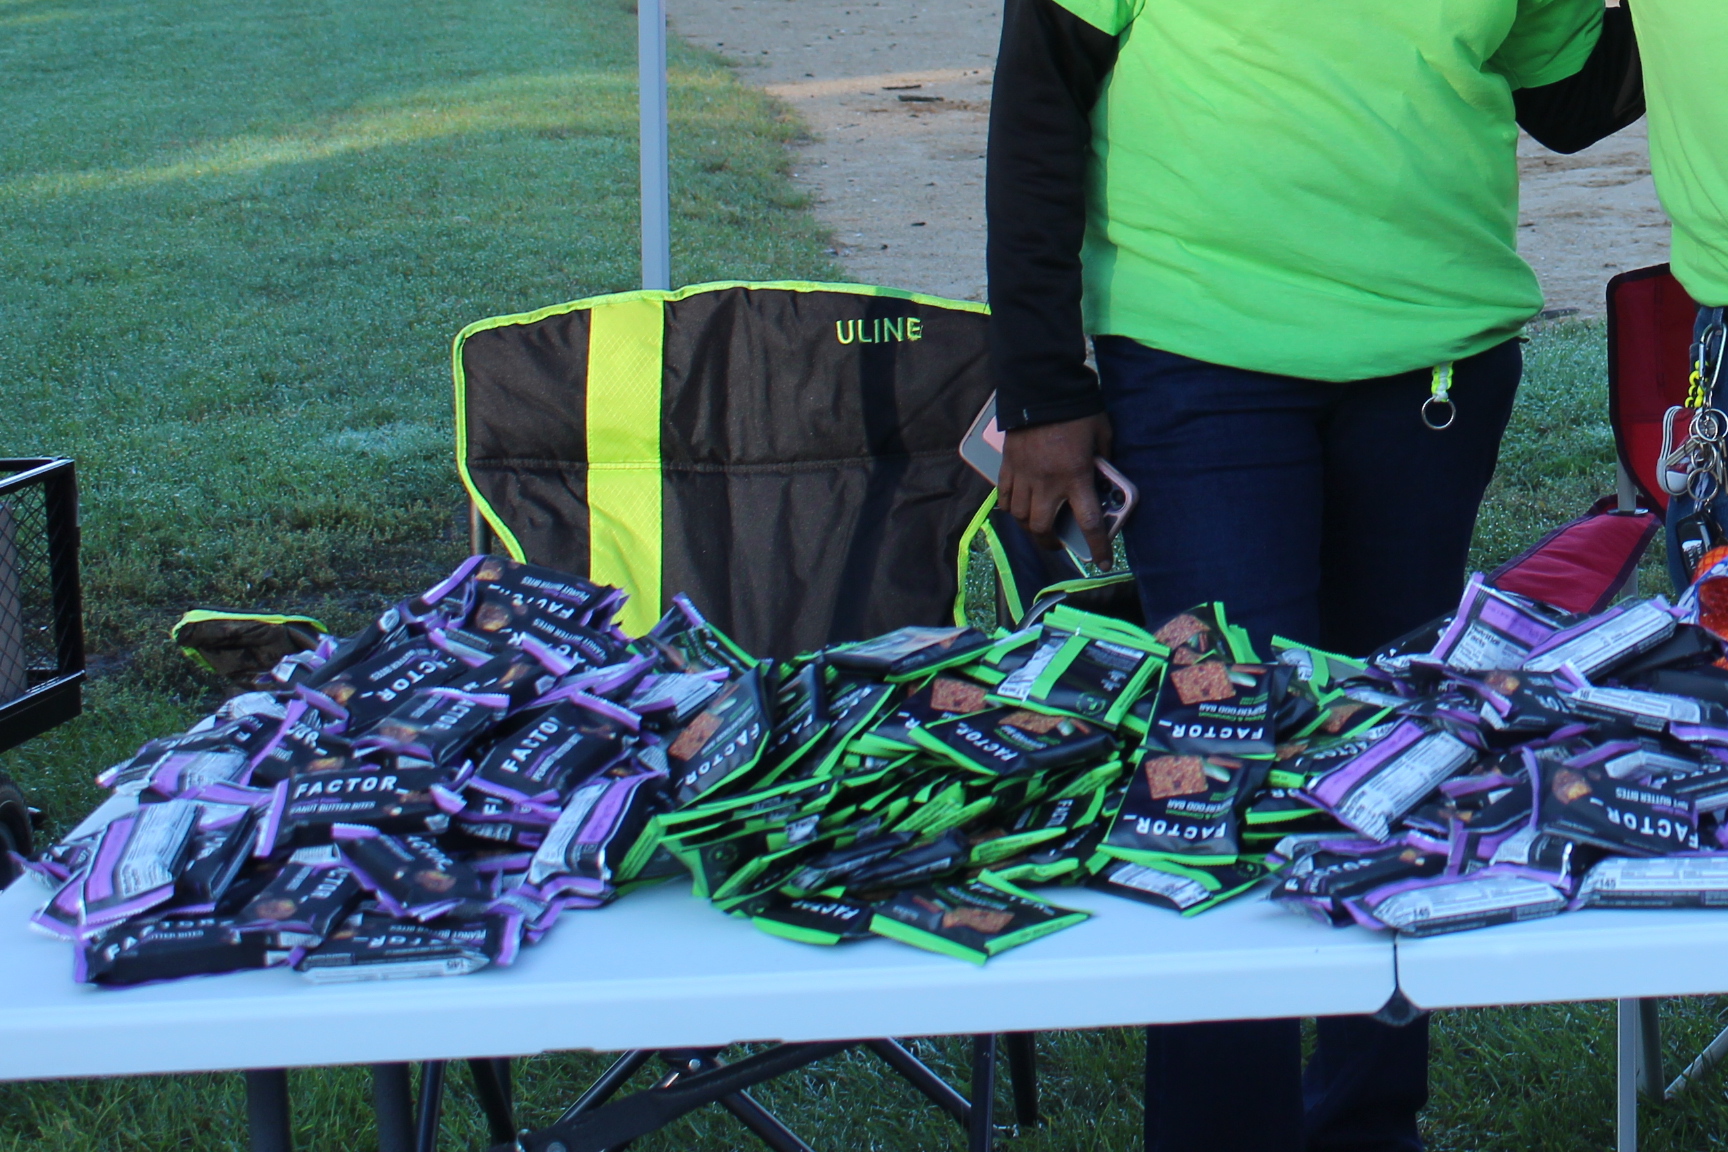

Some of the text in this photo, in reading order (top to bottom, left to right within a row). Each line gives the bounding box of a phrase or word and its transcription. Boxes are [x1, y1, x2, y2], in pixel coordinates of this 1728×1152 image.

[836, 316, 922, 344] ULINE
[1199, 704, 1267, 716] SUPERFOOD BAR
[1172, 724, 1264, 740] FACTOR
[684, 722, 760, 786] FACTOR
[294, 775, 398, 798] FACTOR
[1615, 787, 1640, 802] BITES
[318, 801, 351, 813] BUTTER
[351, 800, 376, 810] BITES
[1167, 799, 1186, 809] BAR
[1639, 791, 1672, 807] BUTTER
[1136, 817, 1227, 839] FACTOR
[1606, 806, 1699, 849] FACTOR
[1600, 878, 1616, 889] 145
[1413, 908, 1431, 919] 145
